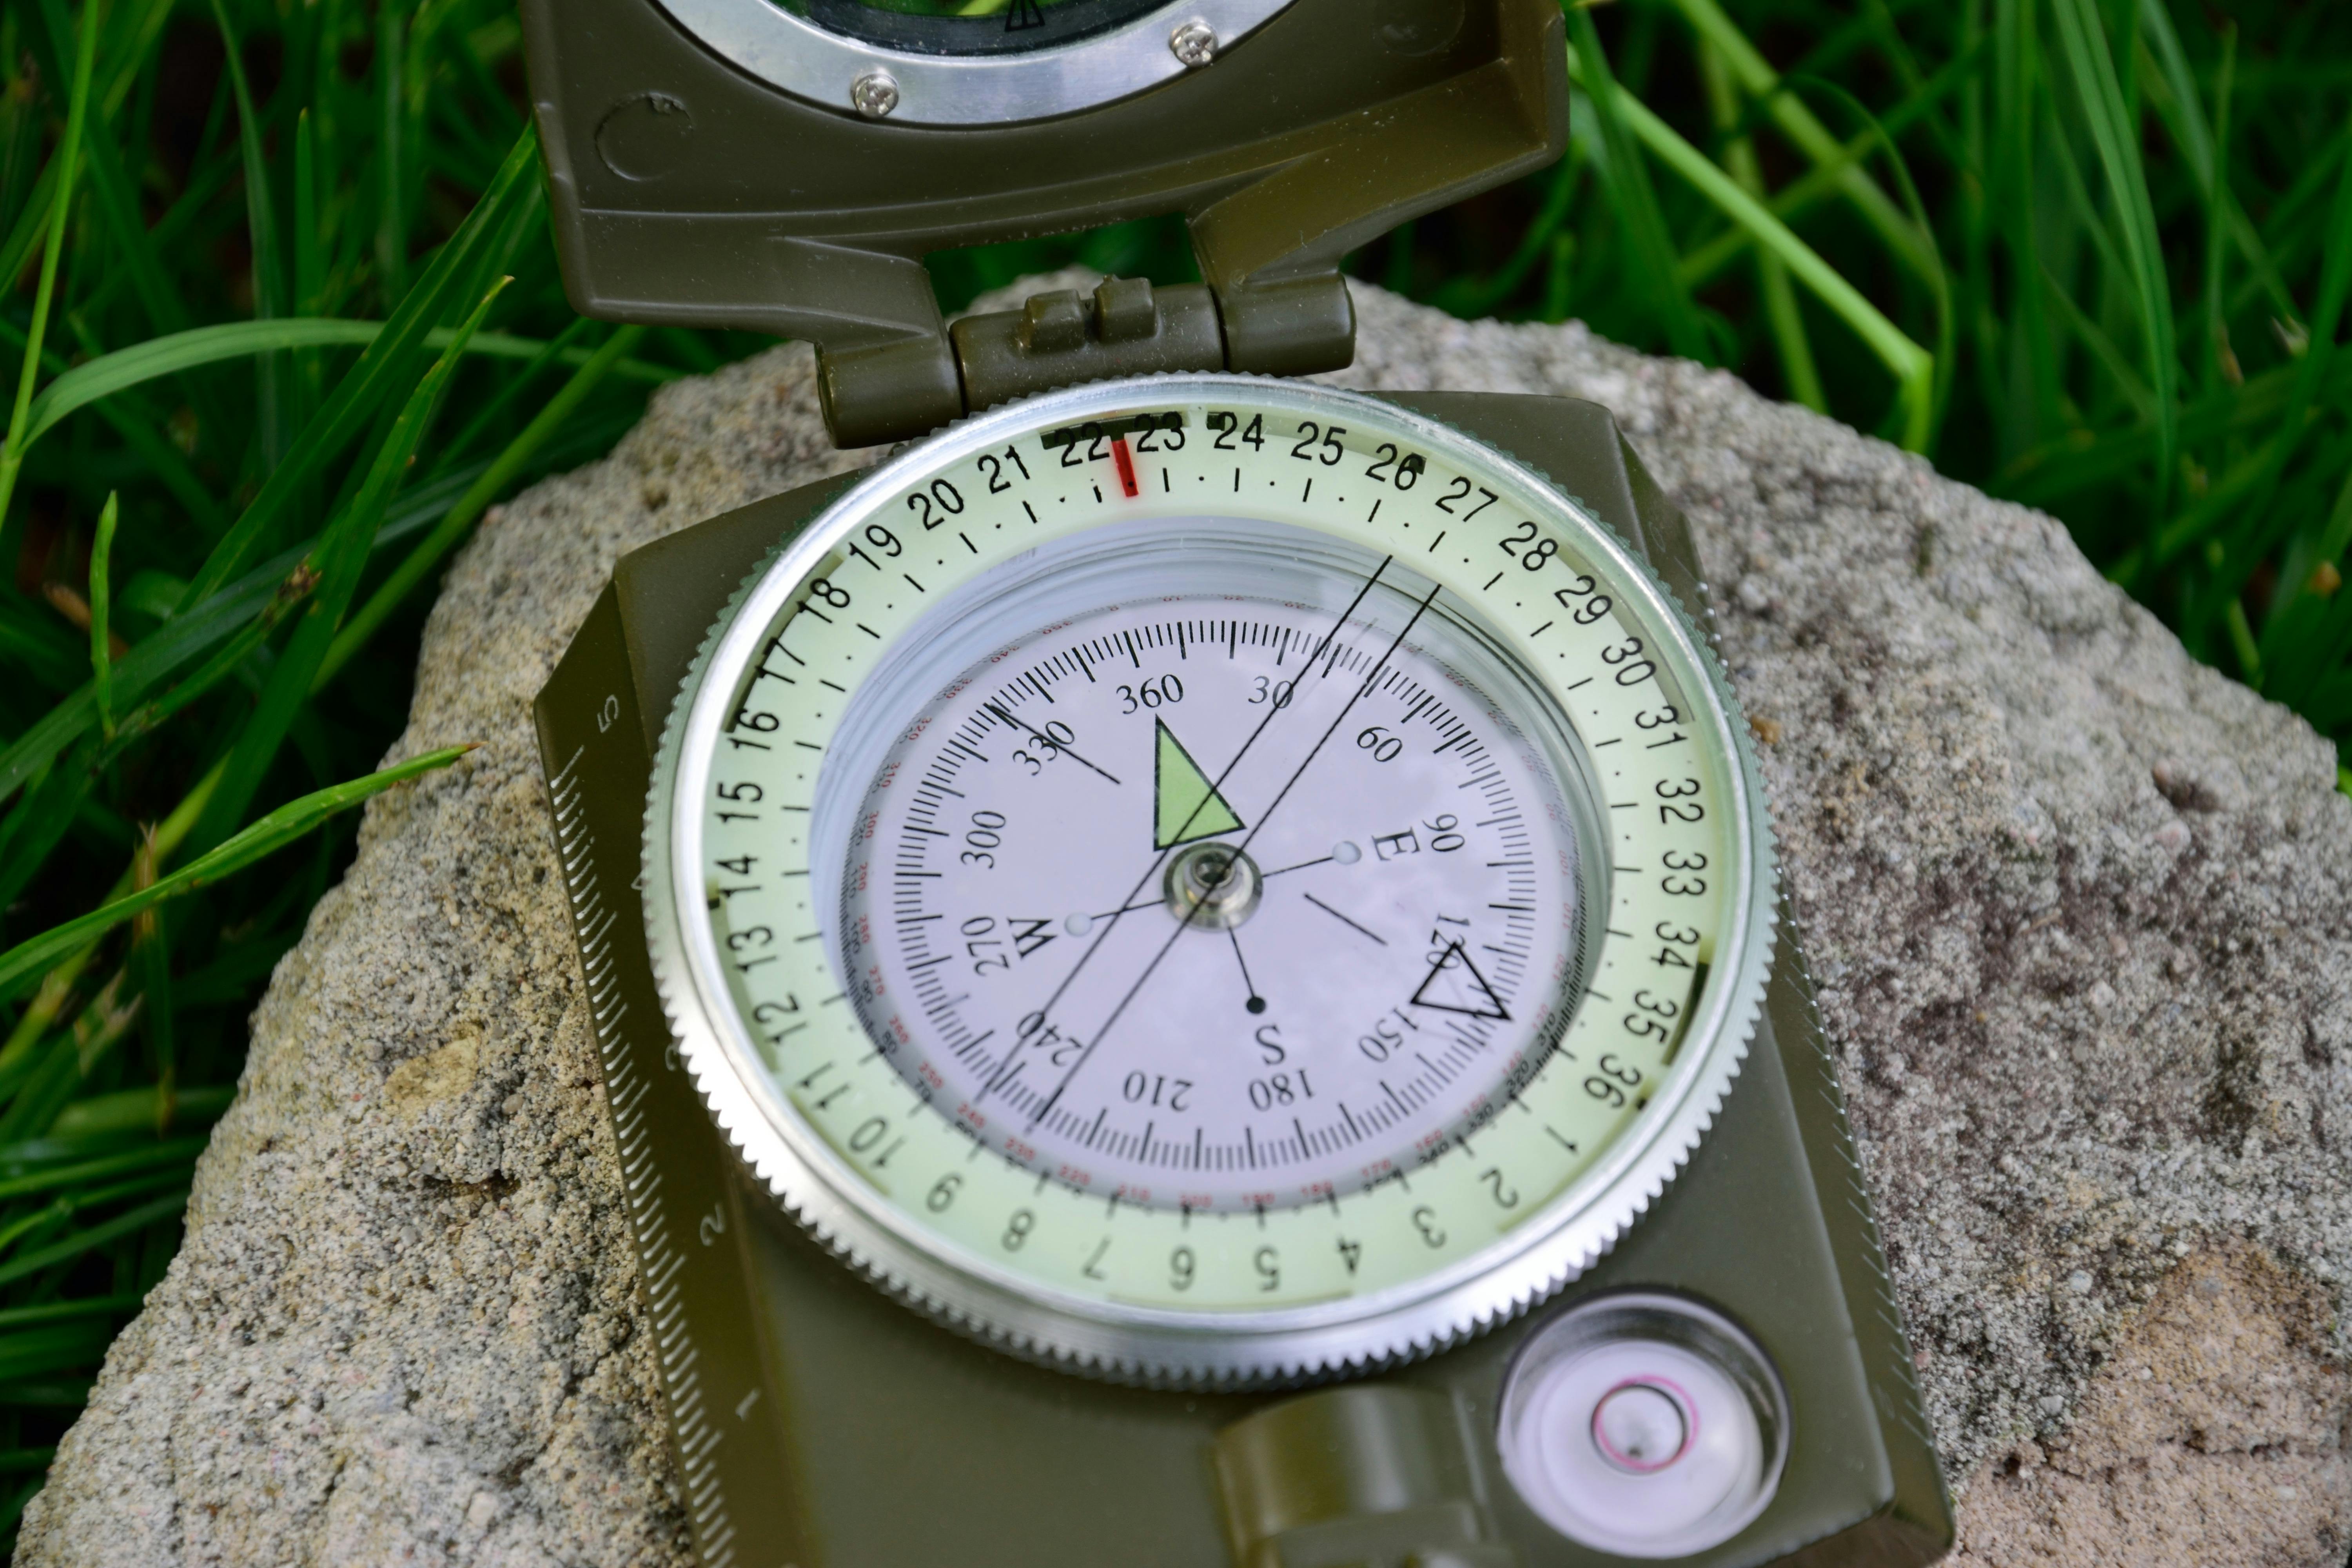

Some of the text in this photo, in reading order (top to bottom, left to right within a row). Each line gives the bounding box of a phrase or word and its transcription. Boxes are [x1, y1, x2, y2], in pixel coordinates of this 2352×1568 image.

[1053, 421, 1109, 468] 22
[1134, 412, 1185, 452] 23
[1214, 412, 1265, 452] 24
[1290, 421, 1347, 465] 25
[977, 445, 1031, 494] 21
[1365, 443, 1425, 491] 26
[908, 479, 964, 530] 20
[1435, 476, 1499, 523] 27
[849, 524, 902, 571] 19
[1498, 521, 1559, 571] 28
[796, 578, 850, 623] 18
[1553, 575, 1613, 625] 29
[756, 637, 806, 684] 17
[1601, 637, 1656, 686] 30
[597, 695, 619, 733] 5
[1116, 674, 1184, 715] 360
[1248, 675, 1294, 709] 30
[727, 708, 779, 750] 16
[1012, 720, 1075, 776] 330
[1356, 726, 1403, 762] 60
[1635, 705, 1688, 749] 31
[714, 782, 763, 824] 15
[1655, 778, 1705, 824] 32
[865, 811, 879, 839] 300
[960, 810, 1006, 869] 300
[1372, 826, 1421, 861] E
[1422, 814, 1465, 852] 90
[714, 855, 762, 897] 14
[1661, 850, 1708, 896] 33
[726, 926, 777, 973] 13
[960, 916, 1011, 977] 270
[1006, 917, 1058, 960] W
[1650, 921, 1701, 969] 34
[1553, 953, 1565, 981] 120
[753, 992, 807, 1044] 12
[1016, 1011, 1082, 1067] 240
[1358, 1007, 1419, 1063] 150
[1623, 990, 1678, 1044] 35
[1255, 1024, 1286, 1066] S
[796, 1061, 852, 1110] 11
[1123, 1070, 1193, 1112] 210
[1248, 1069, 1315, 1112] 180
[1583, 1054, 1642, 1109] 36
[849, 1116, 906, 1170] 10
[1544, 1124, 1581, 1156] 1
[926, 1172, 963, 1214] 9
[1479, 1167, 1520, 1209] 2
[700, 1203, 727, 1246] 2
[1001, 1208, 1036, 1252] 8
[1412, 1205, 1447, 1249] 3
[1082, 1235, 1111, 1281] 7
[1168, 1245, 1196, 1293] 6
[1254, 1245, 1281, 1292] 5
[1337, 1233, 1361, 1277] 4
[736, 1387, 761, 1421] 1
